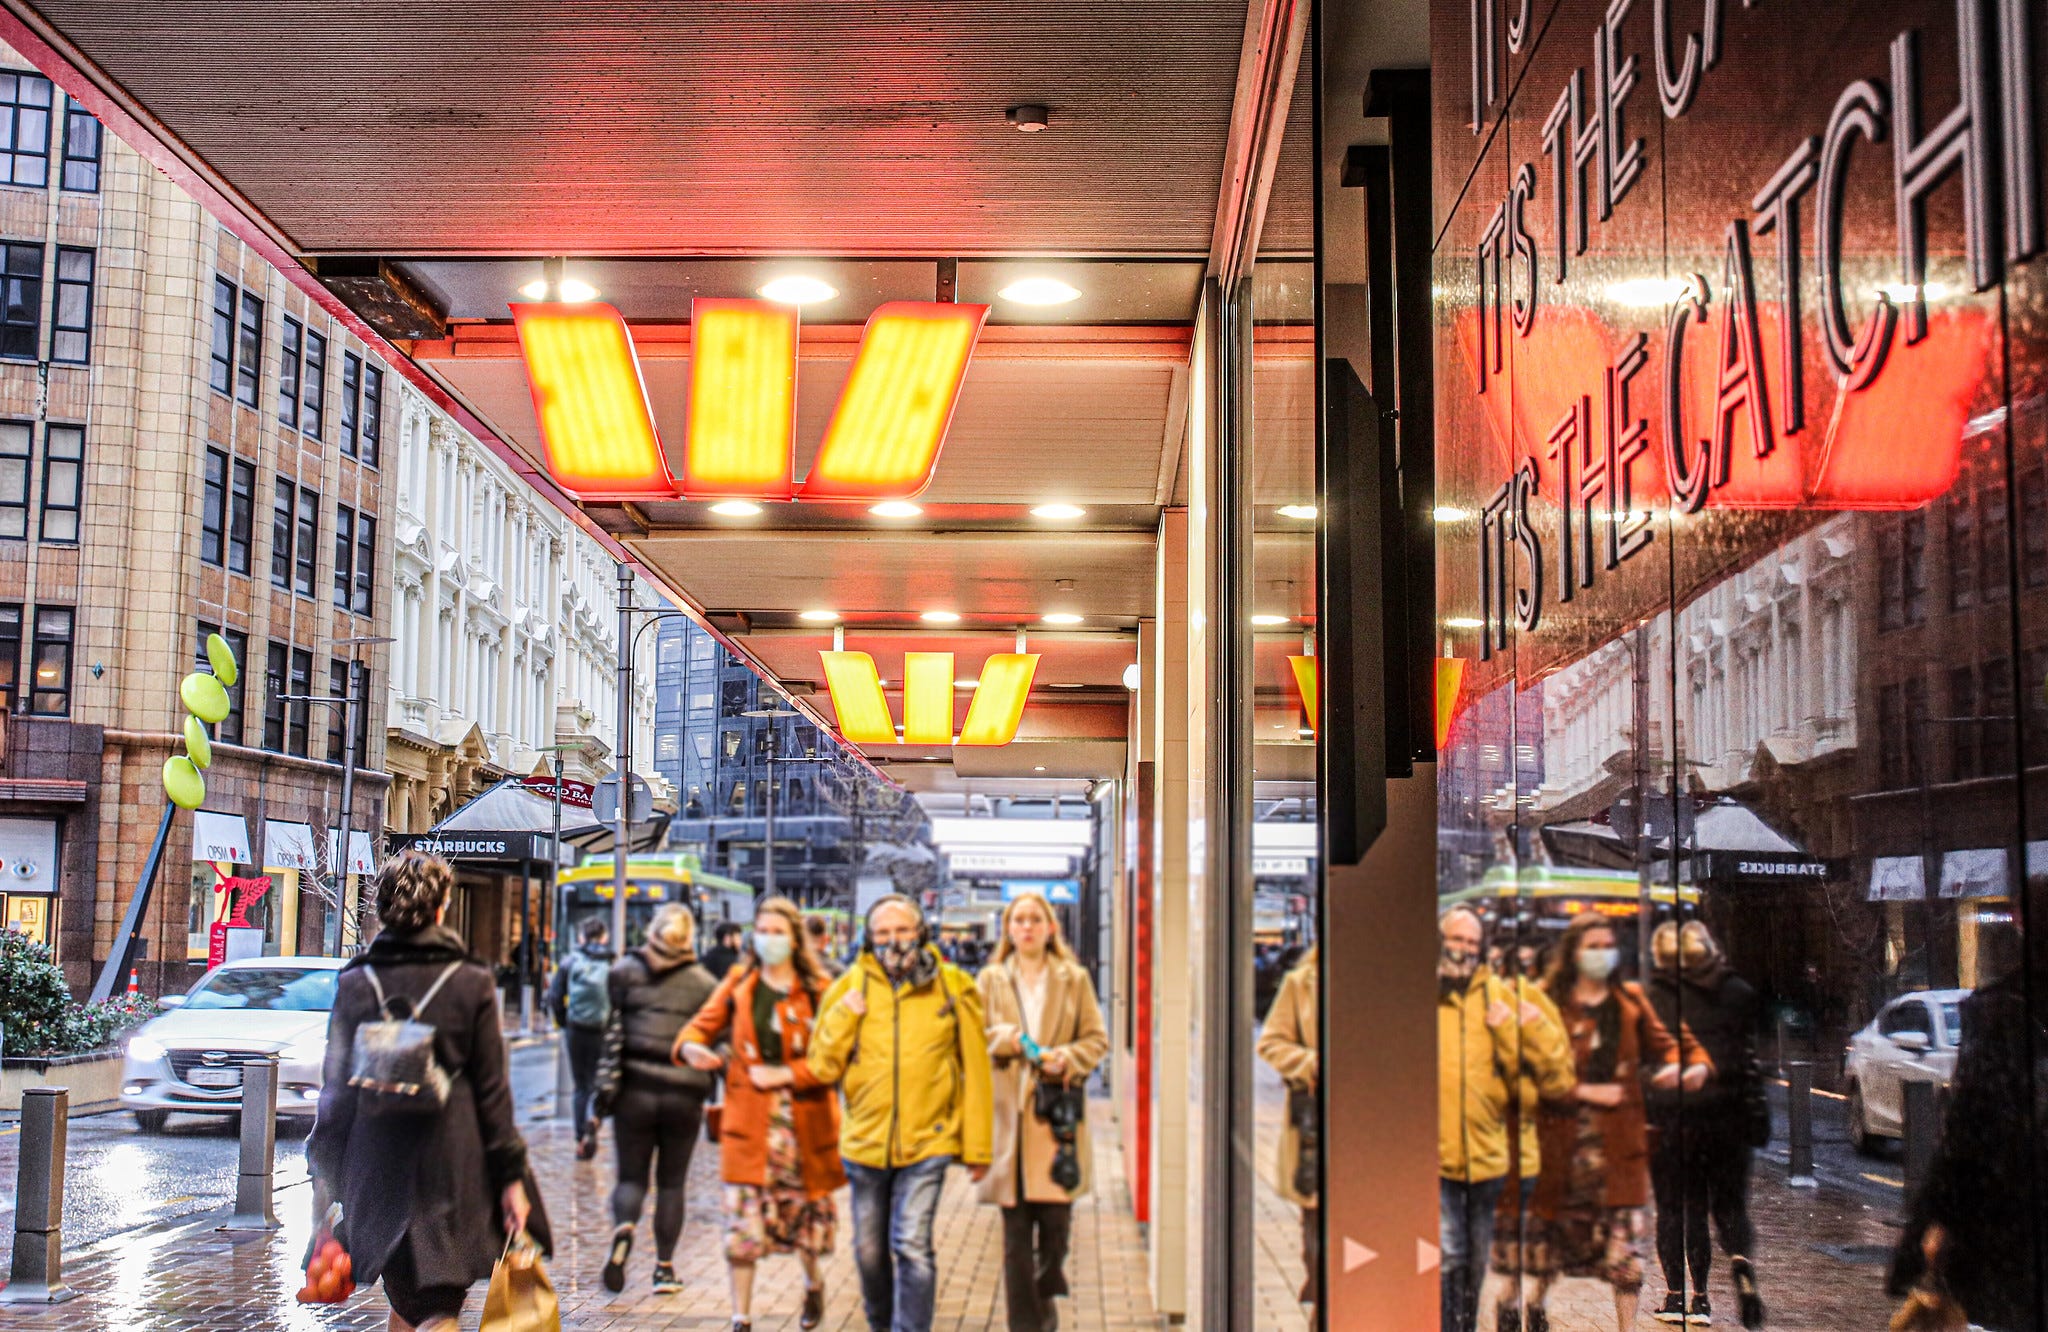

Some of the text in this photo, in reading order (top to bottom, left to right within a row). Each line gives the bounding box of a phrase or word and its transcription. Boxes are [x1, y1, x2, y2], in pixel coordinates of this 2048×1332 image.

[1541, 0, 1647, 285] THE
[1547, 331, 1654, 603] THE
[571, 790, 594, 802] BA
[208, 844, 229, 861] OPSM
[414, 840, 506, 854] STARBUCKS
